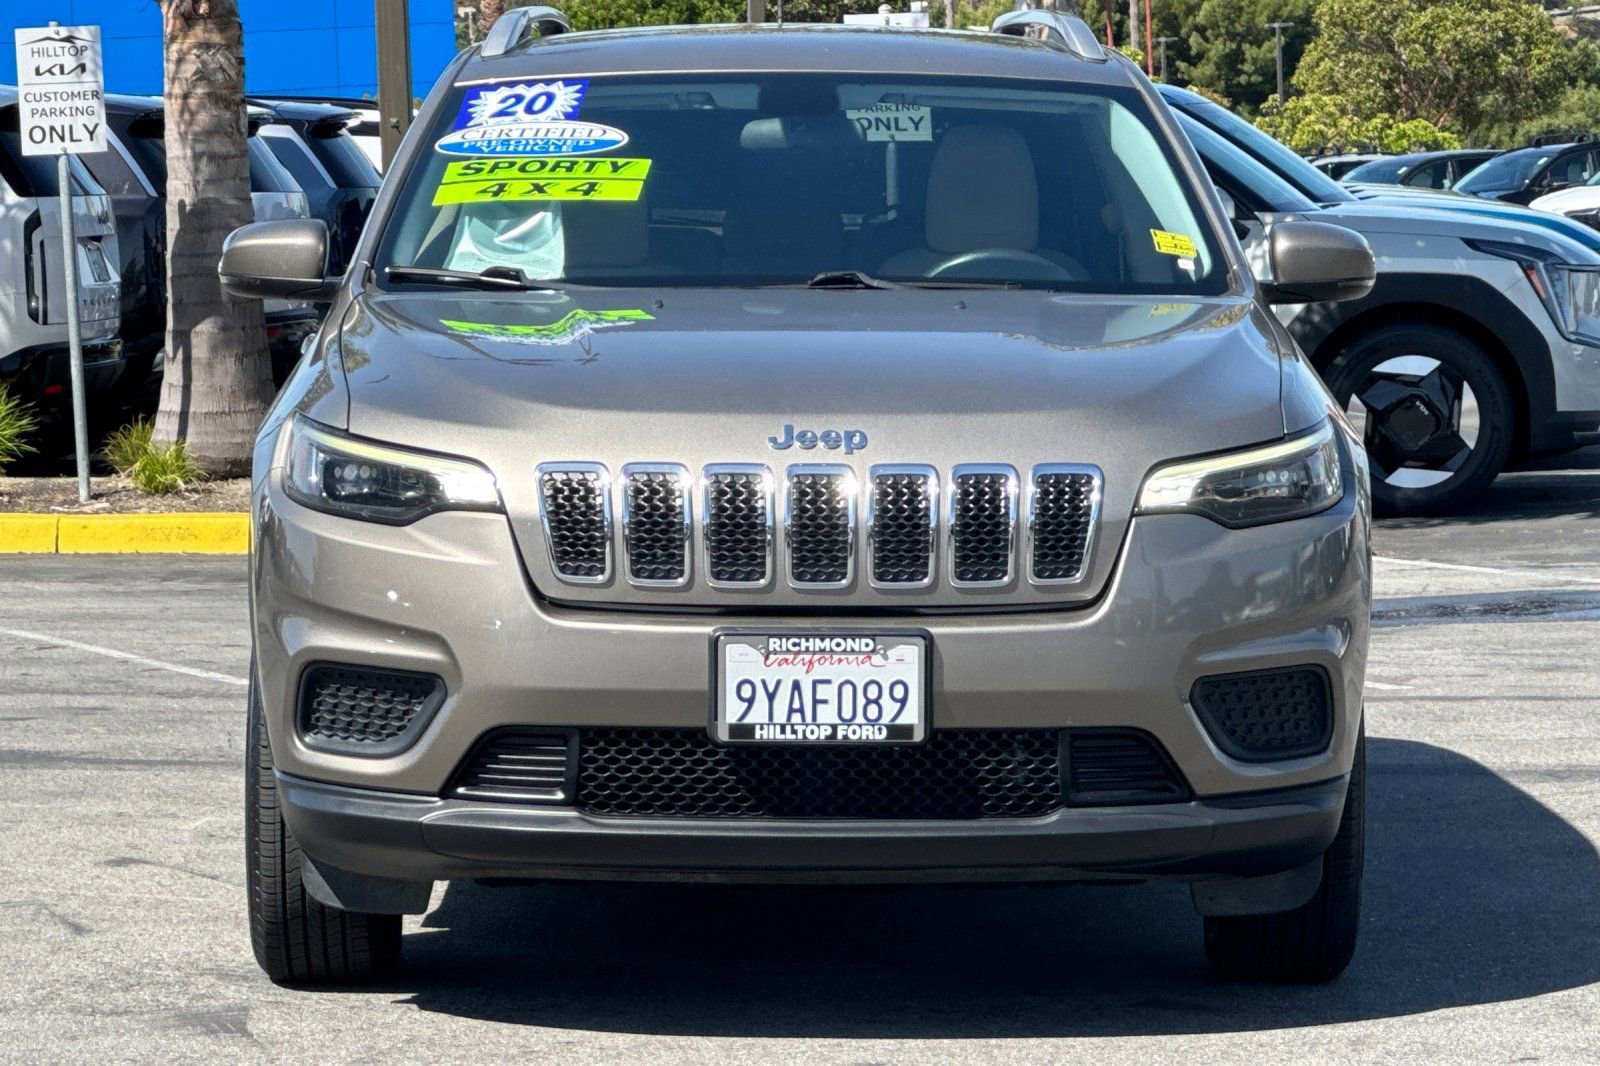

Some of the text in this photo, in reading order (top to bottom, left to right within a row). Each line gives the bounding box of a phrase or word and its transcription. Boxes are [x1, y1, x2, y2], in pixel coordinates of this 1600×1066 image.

[31, 45, 88, 58] HILLTOP
[35, 62, 87, 76] KIA
[24, 90, 100, 103] CUSTOMER
[489, 91, 556, 117] 20
[31, 105, 95, 118] PARKING
[28, 123, 100, 144] ONLY
[461, 127, 607, 140] CERTIFIED
[463, 138, 596, 148] PRE-OWNED
[481, 145, 574, 153] VEHICLE
[457, 159, 635, 177] SPORTY
[768, 424, 868, 455] Jeep
[769, 637, 875, 652] RICHMOND
[763, 651, 887, 674] California
[735, 678, 909, 724] 9YAF089
[755, 725, 887, 740] HILLTOP FORD
